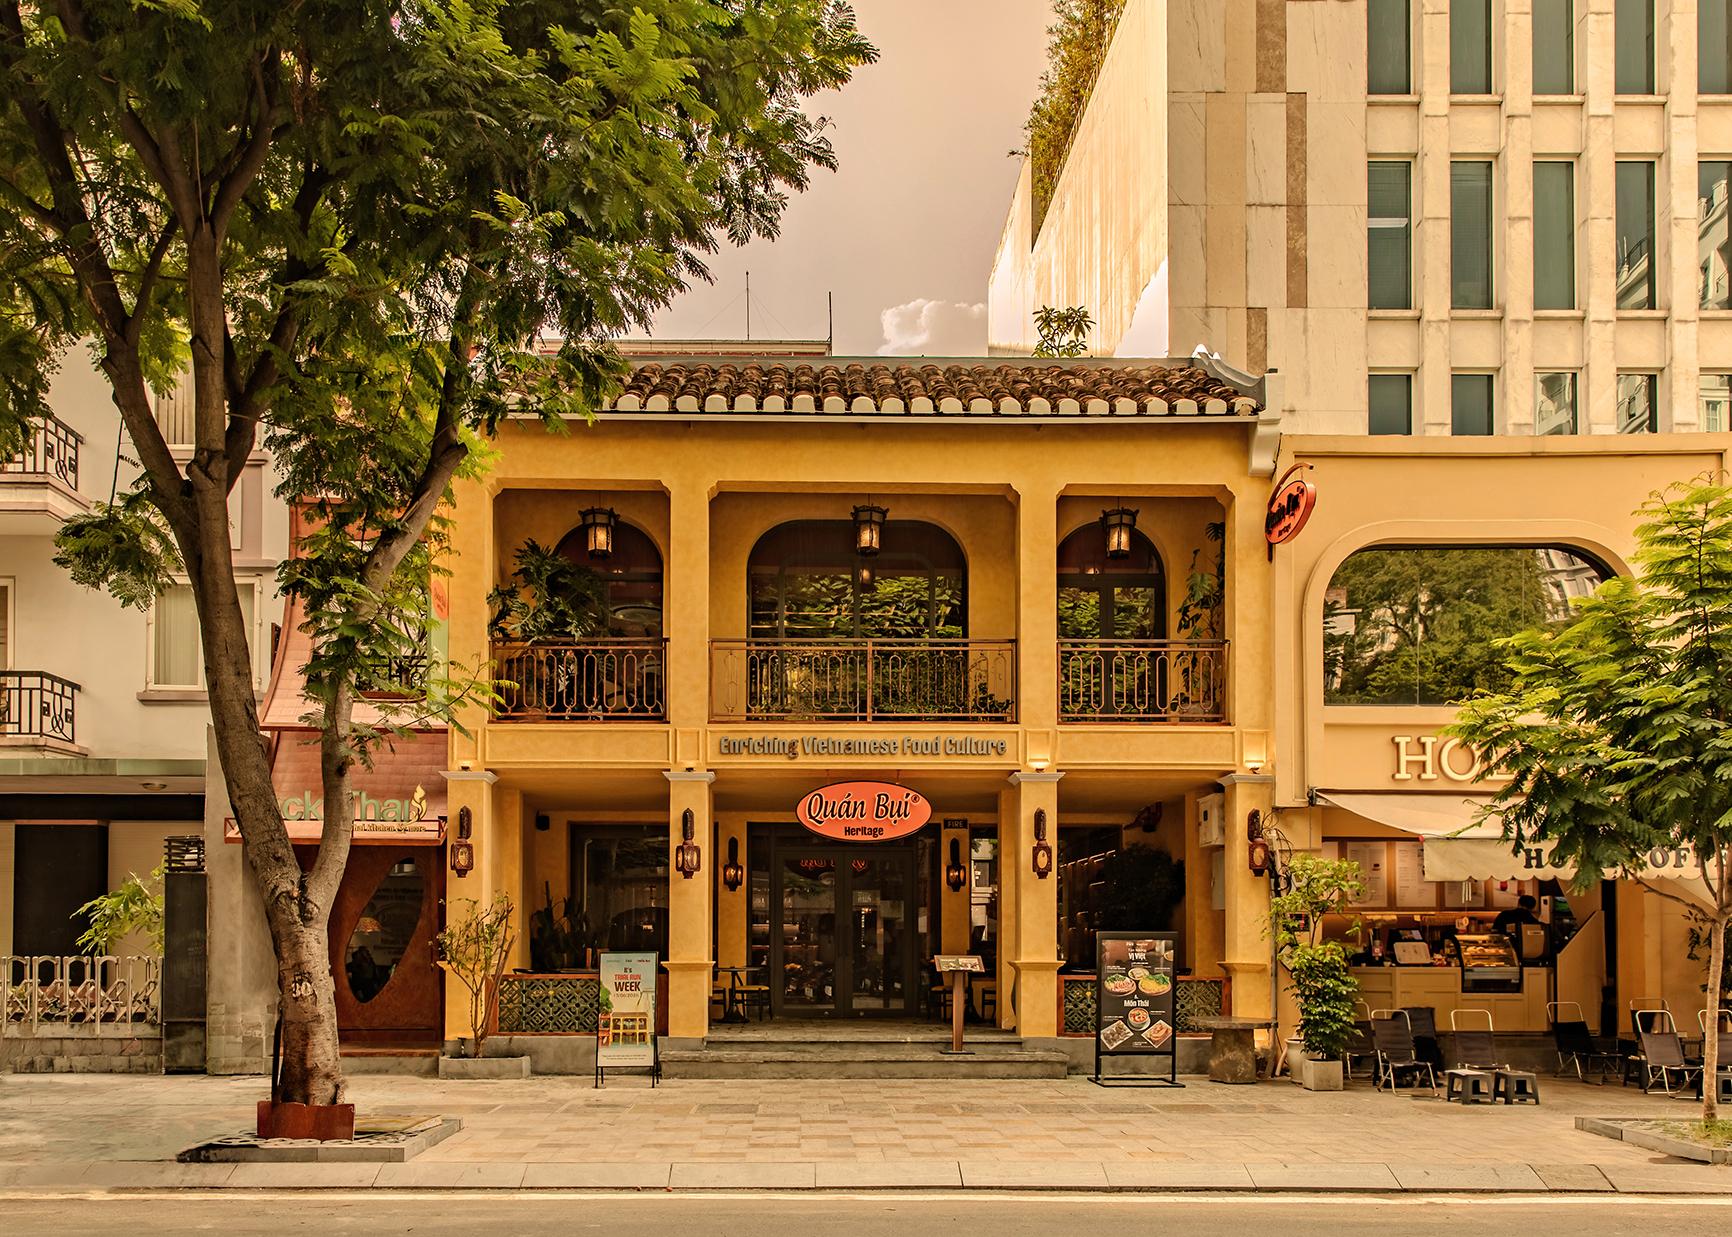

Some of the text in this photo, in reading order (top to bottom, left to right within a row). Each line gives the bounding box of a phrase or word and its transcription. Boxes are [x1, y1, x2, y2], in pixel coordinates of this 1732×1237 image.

[720, 735, 1008, 760] Enriching Vietnamese Food Culture
[807, 792, 867, 825] Quán
[366, 824, 395, 833] kitchen
[408, 825, 426, 833] more
[947, 820, 965, 828] FIRE
[844, 825, 884, 839] Heritage
[614, 973, 642, 981] TRIAL RUN
[614, 981, 641, 992] WEEK
